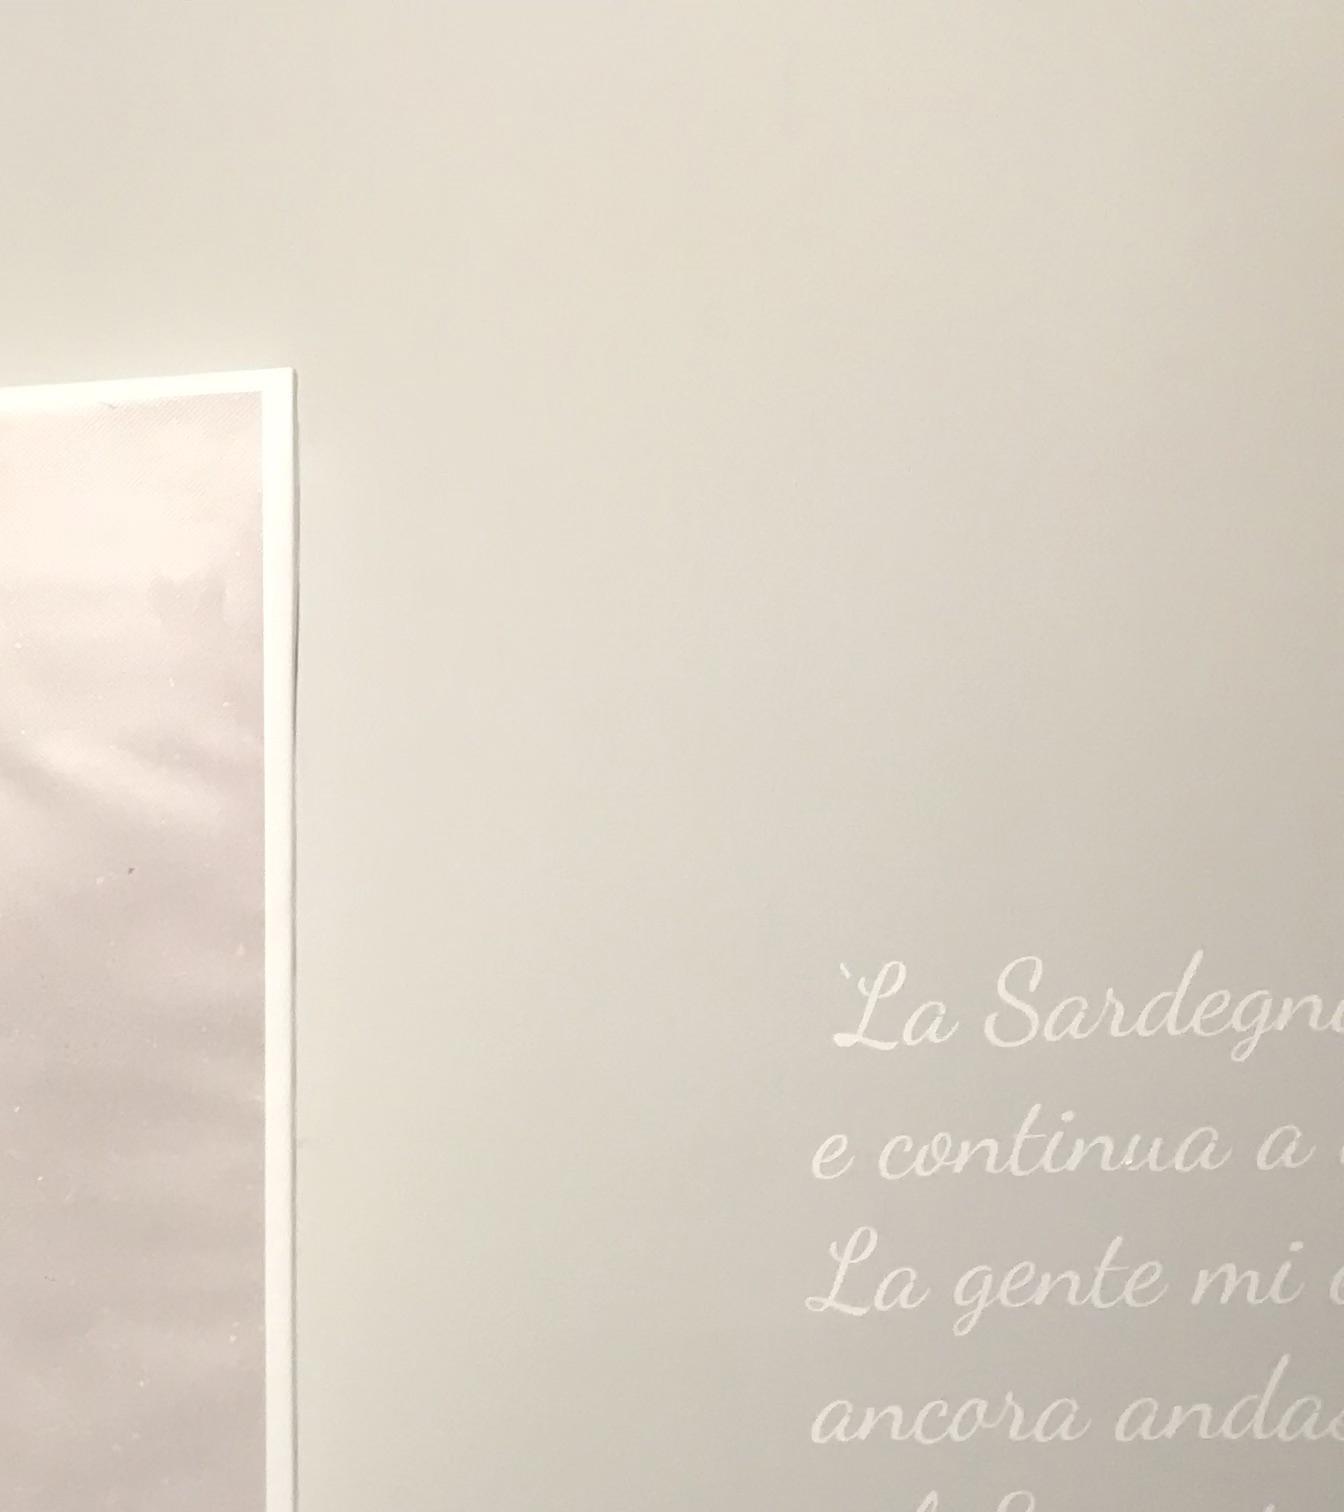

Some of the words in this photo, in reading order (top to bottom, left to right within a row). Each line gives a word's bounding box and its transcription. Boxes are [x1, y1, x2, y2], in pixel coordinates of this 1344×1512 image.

[983, 948, 1344, 1064] Sardegn
[810, 1133, 856, 1181] e
[877, 1102, 1233, 1181] continua
[1255, 1123, 1317, 1171] a
[803, 1225, 931, 1317] La
[951, 1234, 1169, 1337] gente
[1189, 1240, 1305, 1307] mi
[810, 1390, 1093, 1446] ancora
